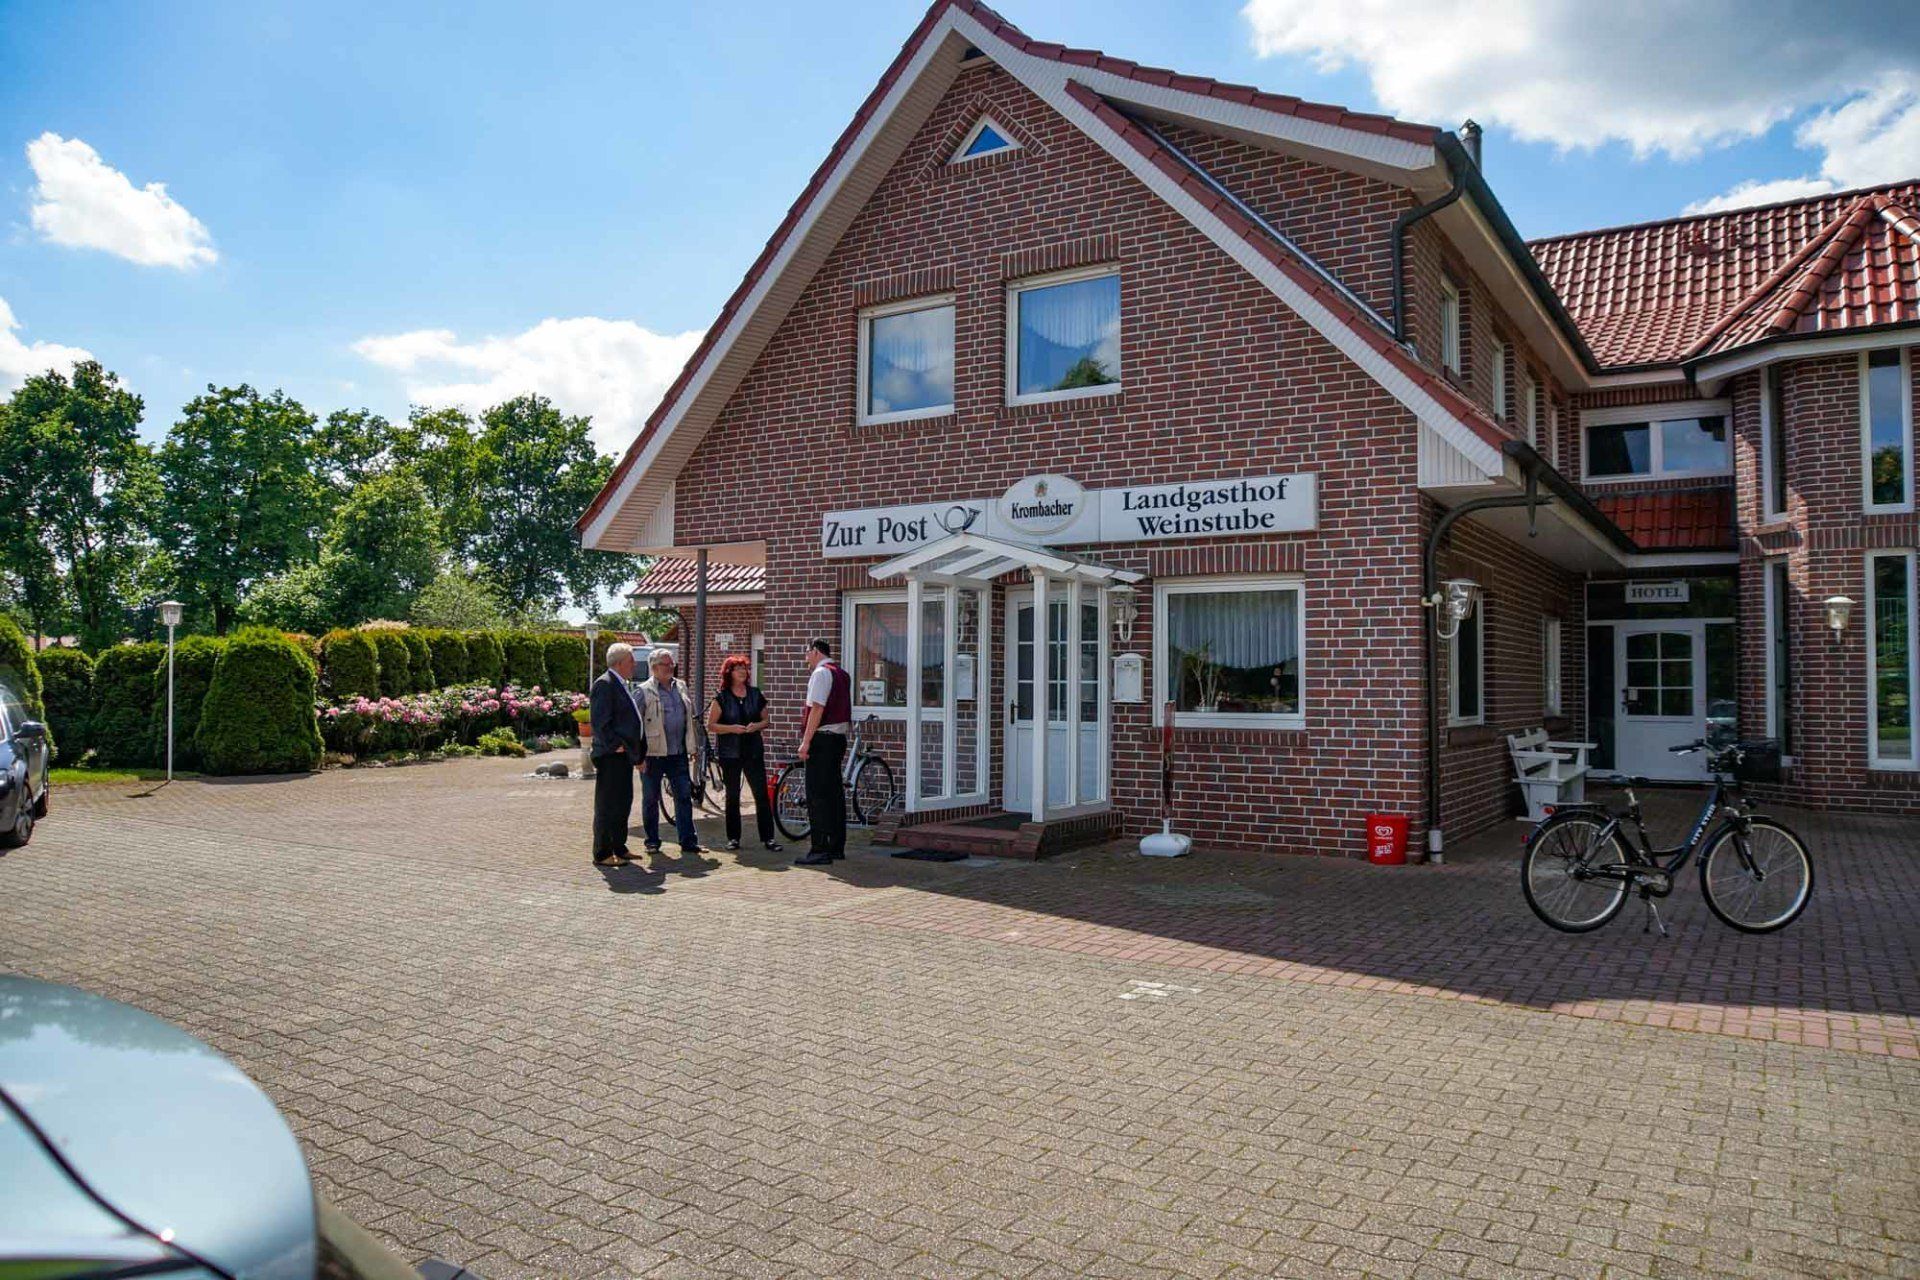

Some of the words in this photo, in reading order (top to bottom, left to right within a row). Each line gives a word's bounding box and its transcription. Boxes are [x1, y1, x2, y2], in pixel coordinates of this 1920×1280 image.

[1122, 478, 1289, 512] Landgasthof
[1011, 499, 1074, 519] Krombacher
[825, 521, 866, 548] Zur
[877, 516, 928, 544] Post
[1137, 508, 1276, 536] Weinstube
[1631, 586, 1684, 598] HOTEL
[1690, 827, 1703, 846] CITY
